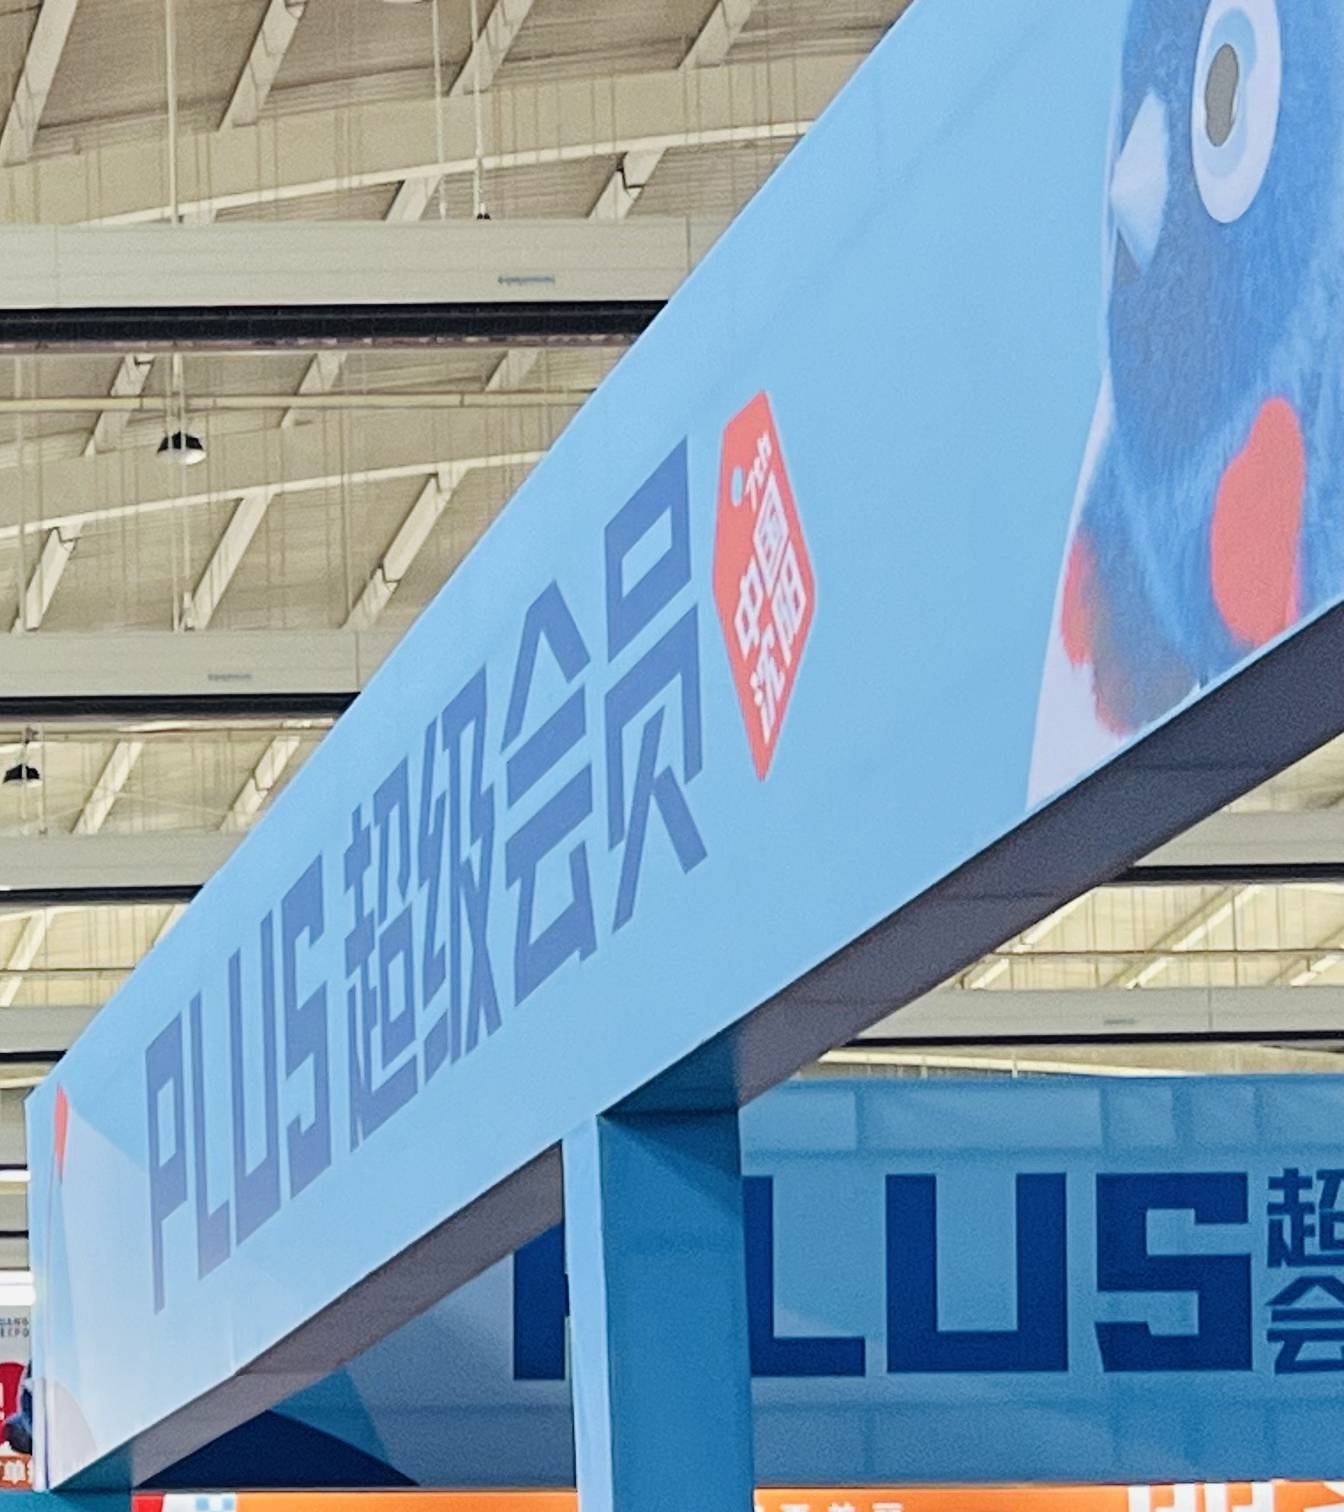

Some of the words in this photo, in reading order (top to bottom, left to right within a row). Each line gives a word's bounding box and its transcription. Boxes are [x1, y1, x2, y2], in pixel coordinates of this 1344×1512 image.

[144, 853, 332, 1314] PLUS
[343, 434, 707, 1152] 超级会员
[513, 1172, 1253, 1381] LUS
